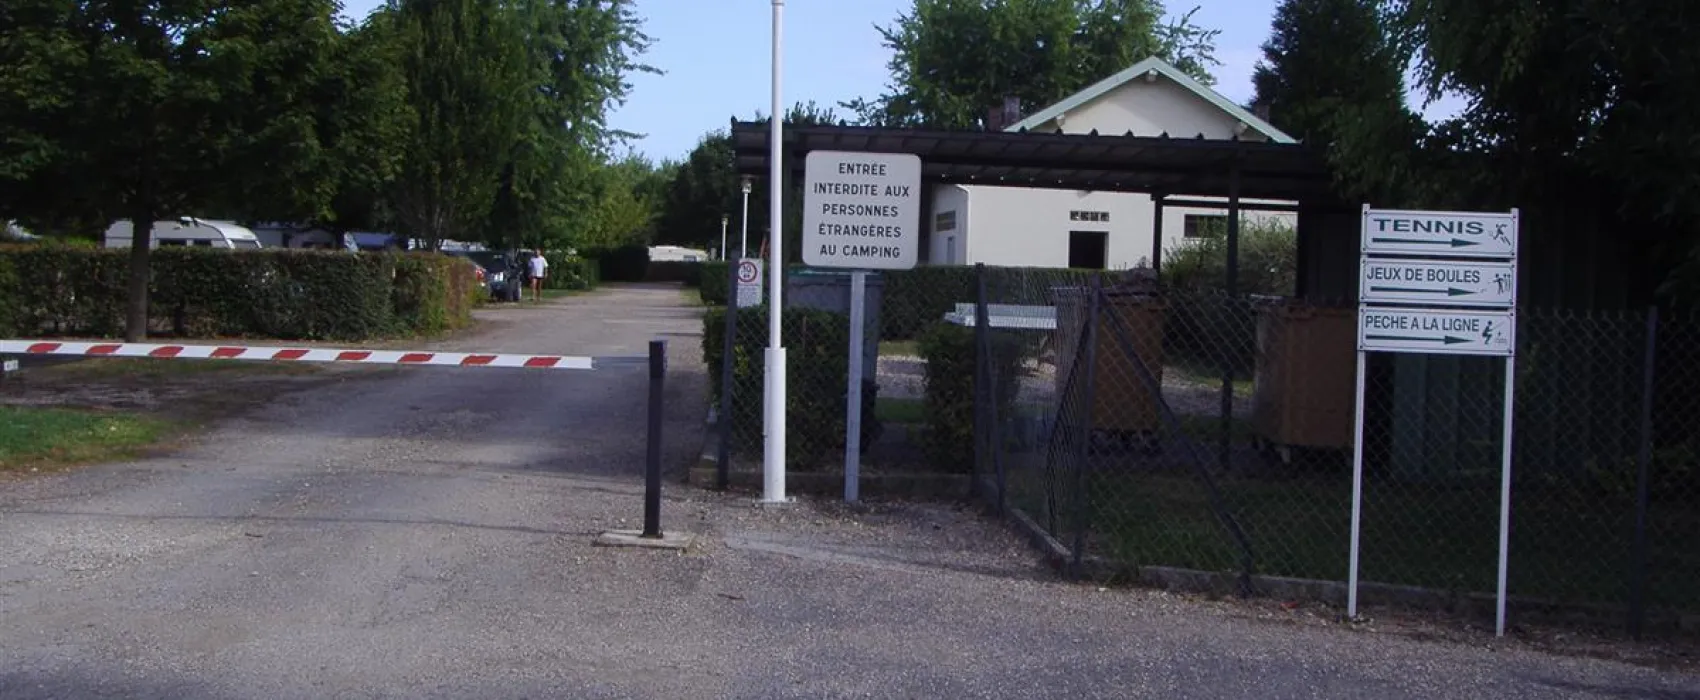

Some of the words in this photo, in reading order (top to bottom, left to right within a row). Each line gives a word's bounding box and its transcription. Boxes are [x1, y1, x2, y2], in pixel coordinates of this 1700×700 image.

[838, 162, 886, 176] ENTRÉE
[814, 182, 878, 196] INTERDITE
[884, 185, 910, 197] AUX
[822, 203, 899, 217] PERSONNES
[818, 220, 902, 238] ÉTRANGÈRES
[1373, 218, 1484, 235] TENNIS
[820, 244, 837, 256] AU
[842, 245, 901, 259] CAMPING
[1367, 267, 1401, 281] JEUX
[1405, 268, 1424, 282] DE
[1427, 269, 1481, 284] BOULES
[1365, 315, 1408, 329] PECHE
[1410, 317, 1420, 330] A
[1423, 318, 1439, 331] LA
[1442, 318, 1480, 332] LIGNE
